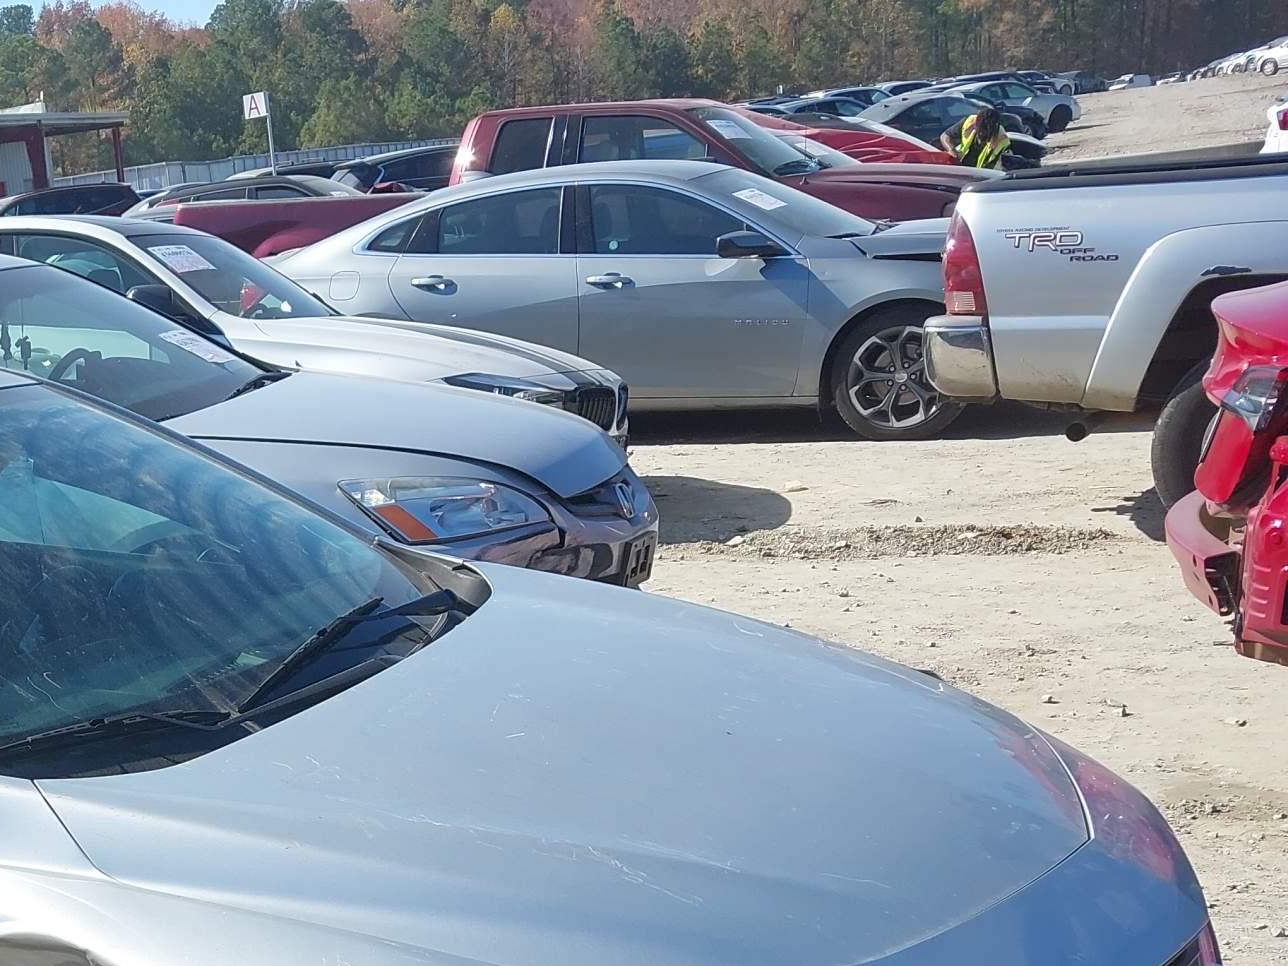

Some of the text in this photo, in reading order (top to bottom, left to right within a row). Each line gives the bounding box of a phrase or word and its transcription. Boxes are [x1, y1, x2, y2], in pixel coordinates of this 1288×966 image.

[248, 95, 261, 118] A
[1005, 231, 1083, 253] TRD
[1059, 247, 1096, 255] OFF
[1069, 254, 1120, 262] ROAD
